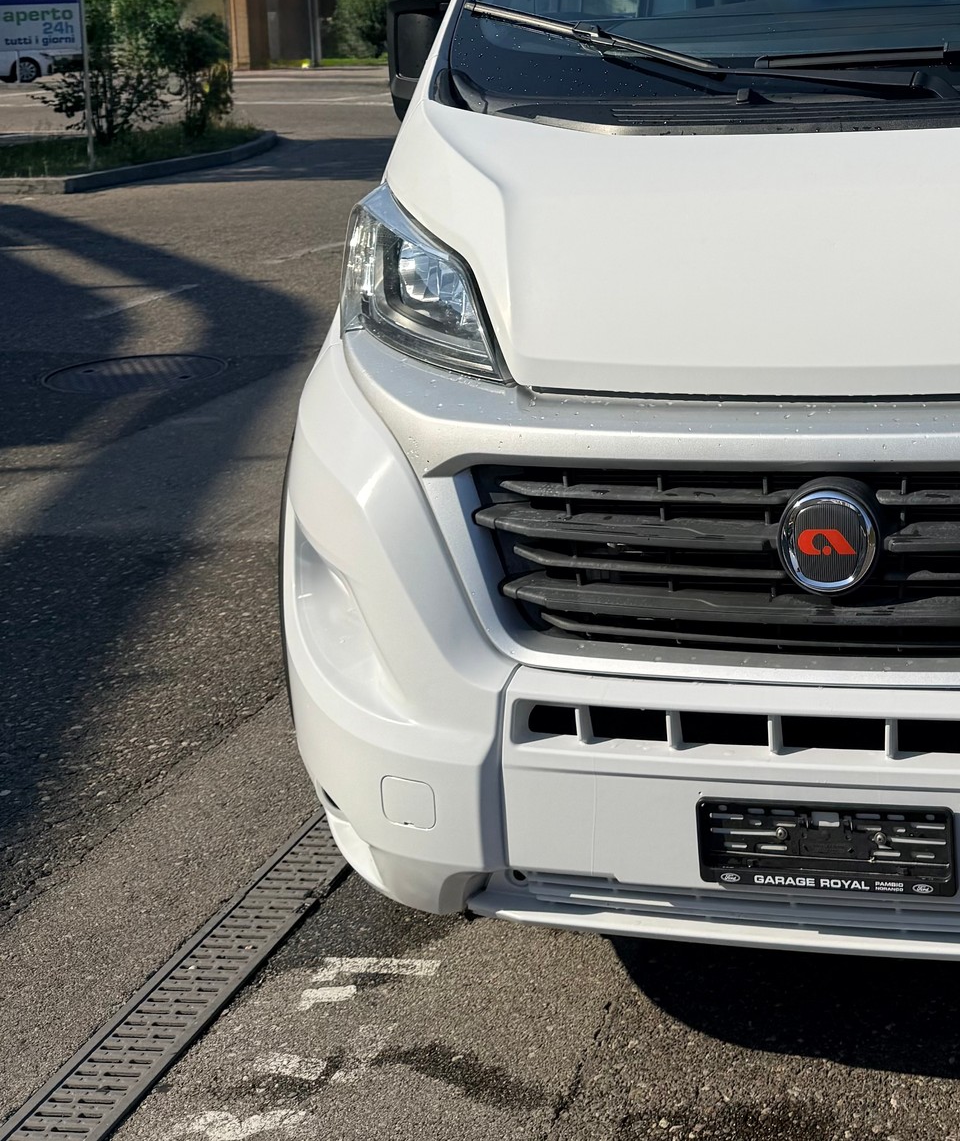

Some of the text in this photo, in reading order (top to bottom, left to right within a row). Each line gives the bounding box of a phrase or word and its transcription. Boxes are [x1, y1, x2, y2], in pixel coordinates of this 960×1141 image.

[3, 8, 73, 26] aperto
[42, 21, 75, 35] 24h
[5, 35, 32, 46] tutti
[42, 34, 76, 47] giorni
[754, 874, 870, 890] GARAGE ROYAL
